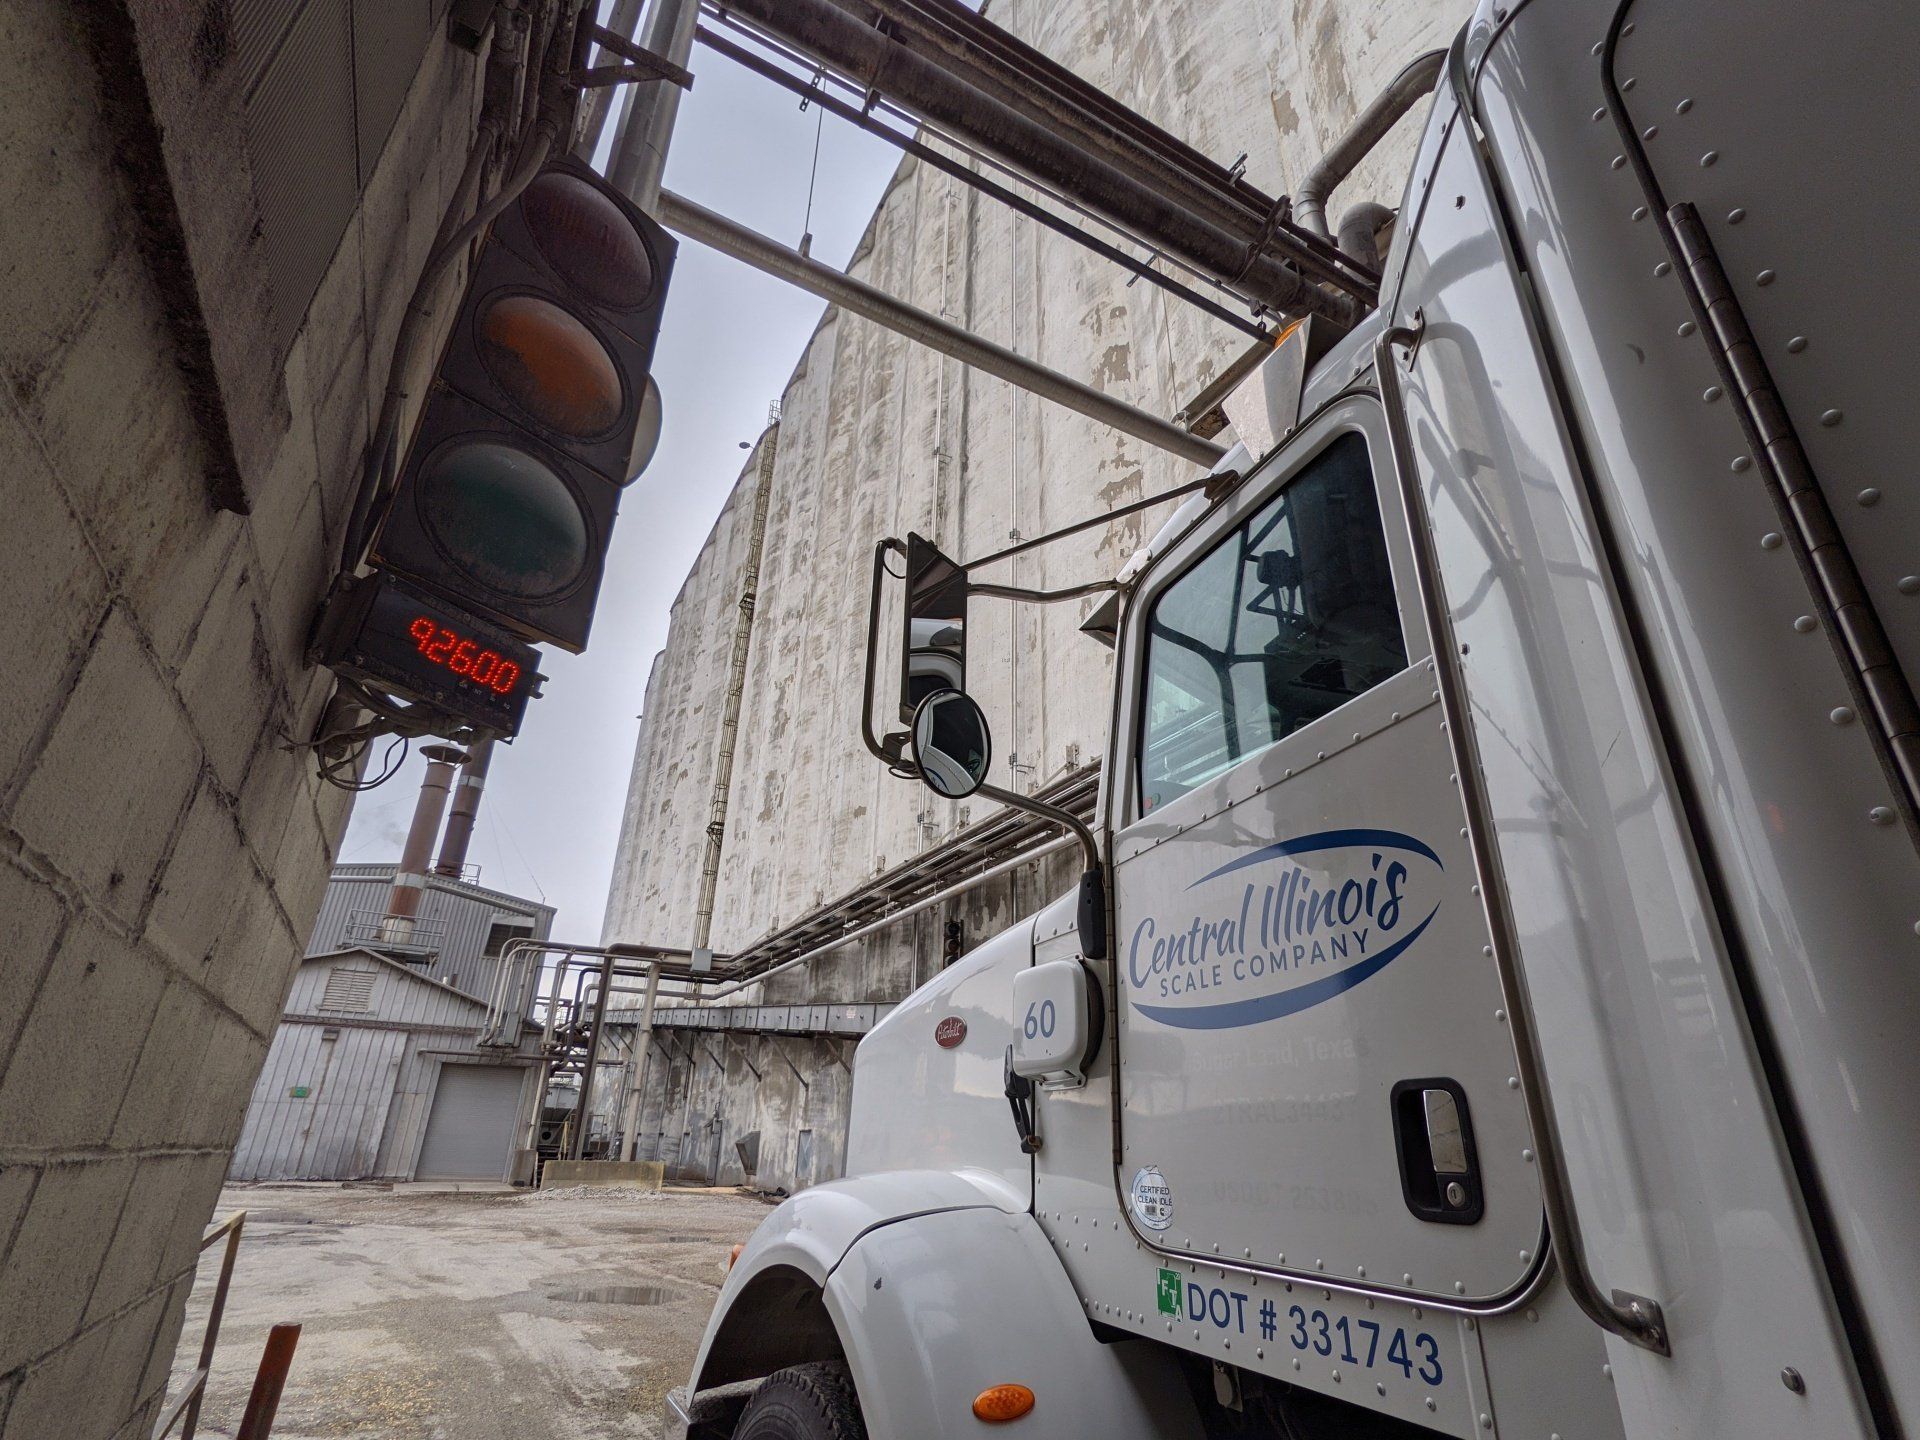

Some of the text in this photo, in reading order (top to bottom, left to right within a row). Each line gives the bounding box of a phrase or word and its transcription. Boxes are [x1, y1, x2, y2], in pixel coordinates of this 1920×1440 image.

[410, 616, 520, 694] 92600
[1129, 853, 1407, 989] Central Illinois
[1160, 928, 1369, 998] SCALE COMPANY
[1024, 1000, 1056, 1040] 60
[1138, 1195, 1173, 1207] CLEAN IDLE
[1140, 1185, 1170, 1196] CERTIFIED
[1187, 1282, 1444, 1387] DOT # 331743
